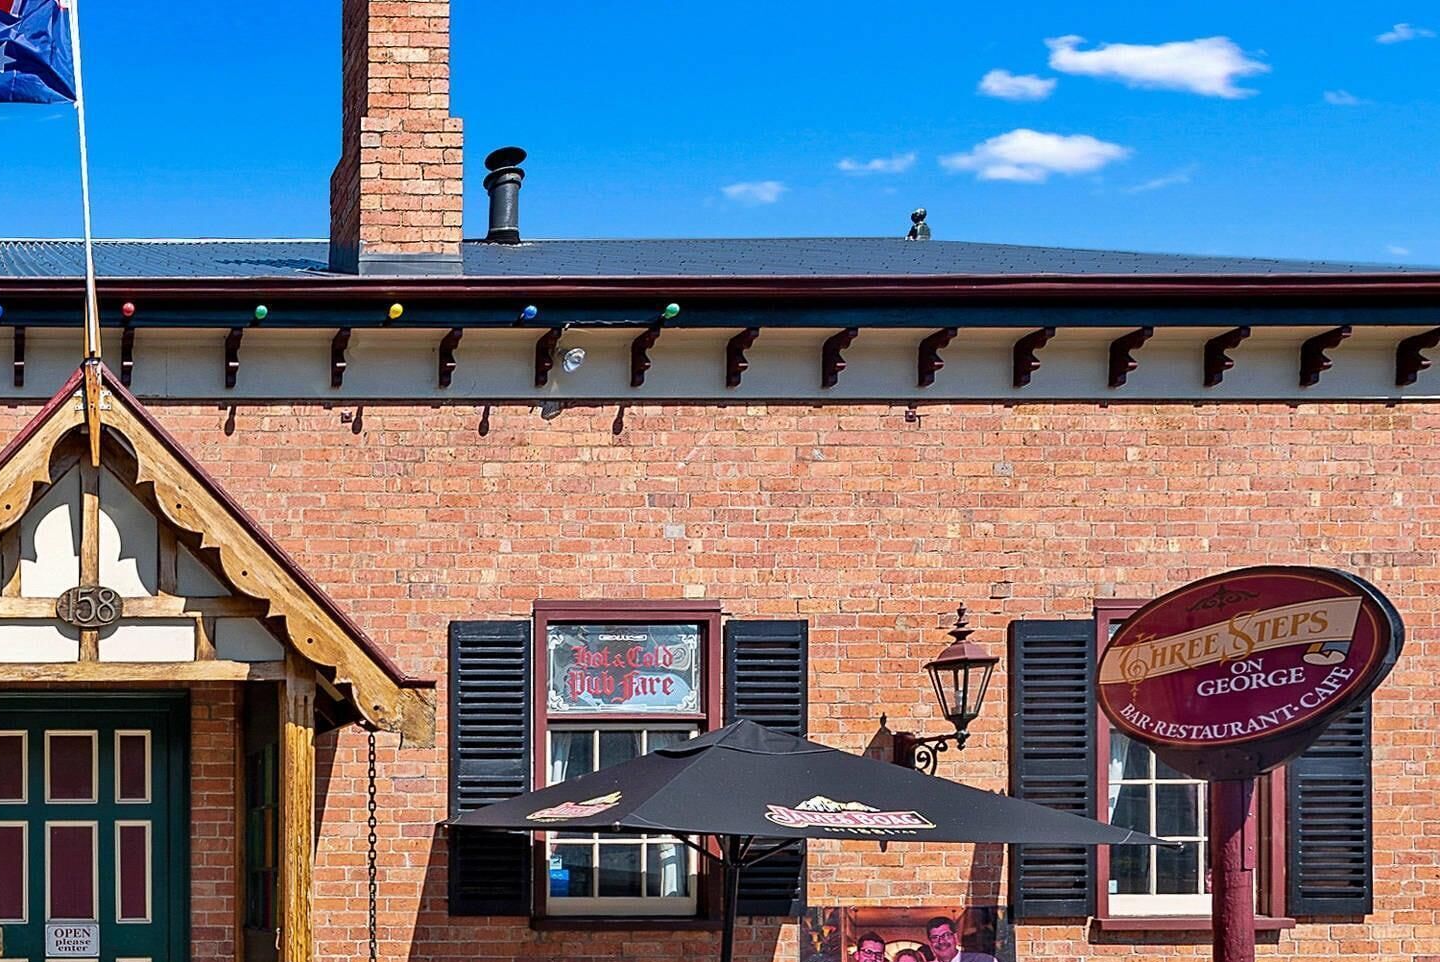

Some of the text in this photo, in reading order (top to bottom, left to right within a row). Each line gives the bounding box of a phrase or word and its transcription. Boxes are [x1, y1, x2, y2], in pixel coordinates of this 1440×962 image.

[66, 588, 116, 622] 158
[612, 653, 626, 669] &
[626, 645, 674, 668] Cold
[1231, 658, 1264, 675] ON
[567, 670, 674, 704] Pub Fare
[1196, 667, 1306, 697] GEORGE
[854, 812, 923, 826] BOAG
[54, 928, 92, 938] OPEN
[55, 938, 92, 947] please
